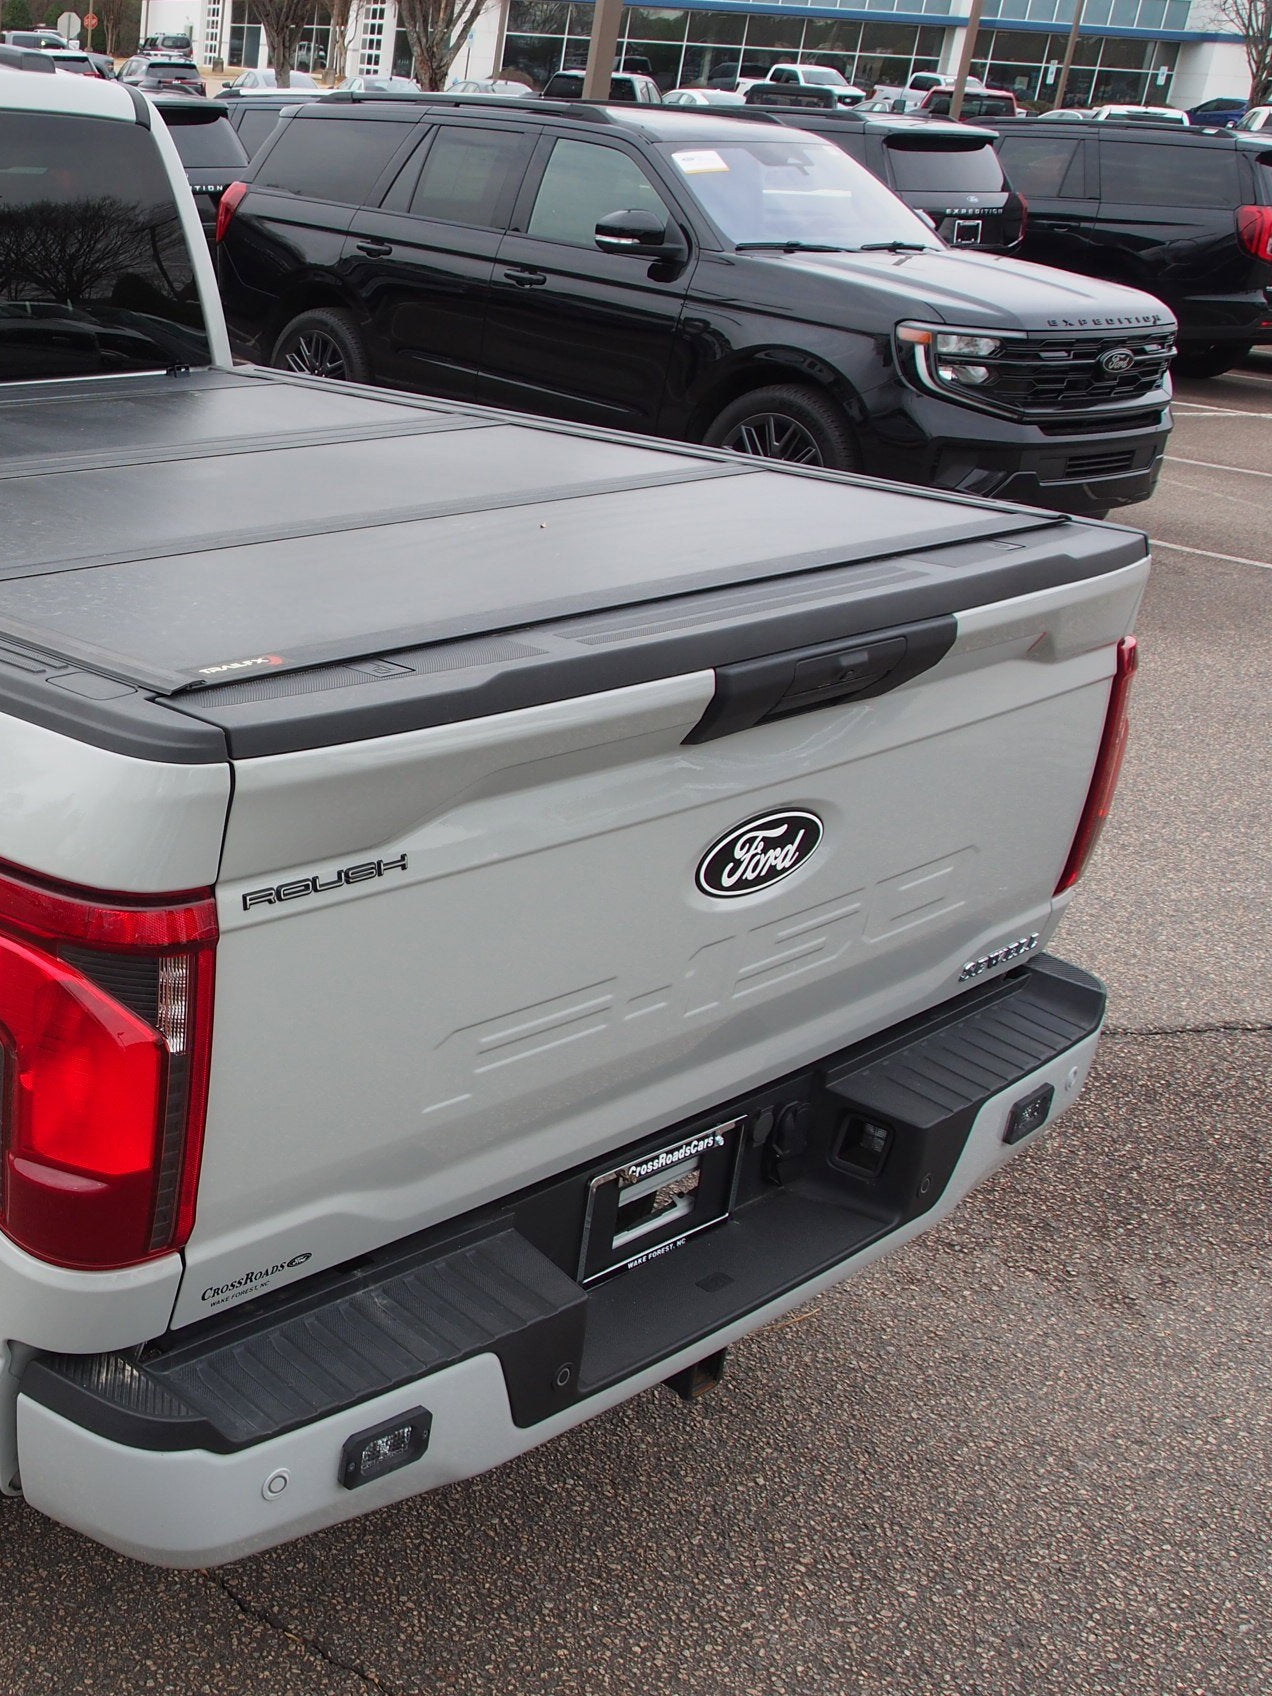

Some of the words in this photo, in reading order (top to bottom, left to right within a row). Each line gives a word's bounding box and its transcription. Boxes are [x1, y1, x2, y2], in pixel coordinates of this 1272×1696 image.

[1047, 314, 1162, 327] EXPEDITION
[721, 823, 806, 888] Ford
[242, 853, 409, 911] ROUSH
[628, 1254, 647, 1269] WAKE
[676, 1237, 687, 1248] NC
[210, 1296, 229, 1307] WAKE
